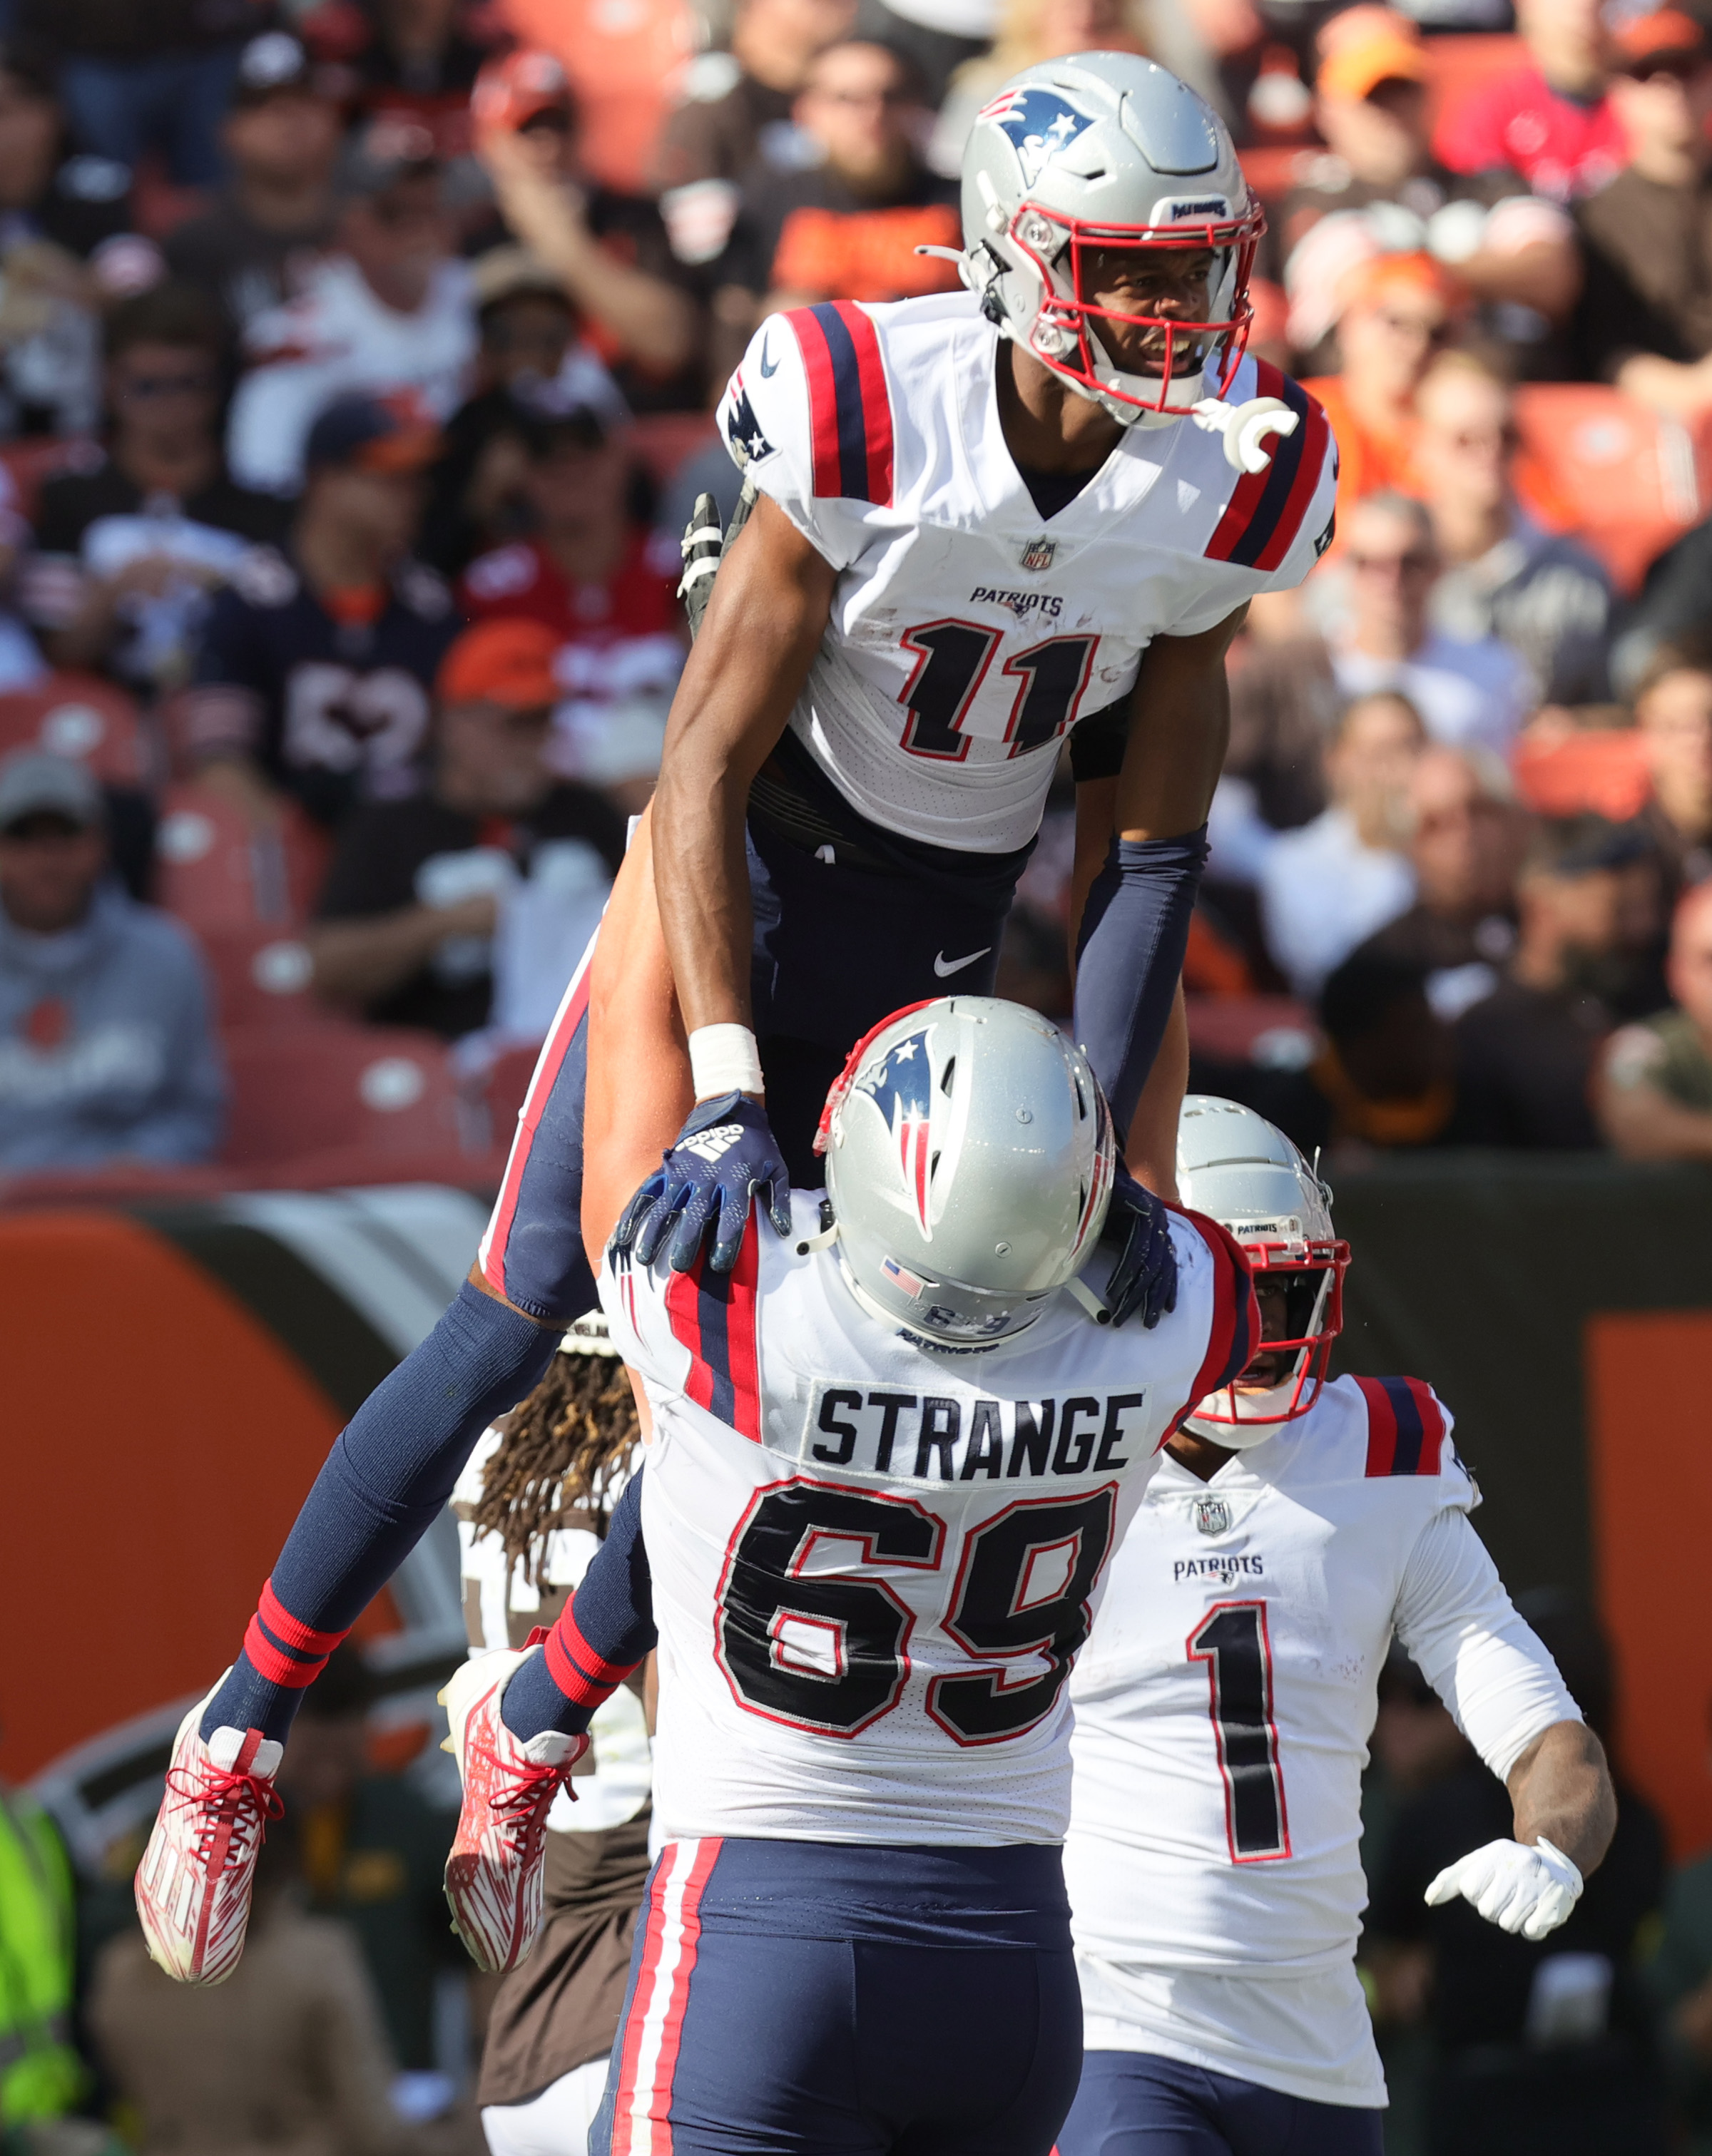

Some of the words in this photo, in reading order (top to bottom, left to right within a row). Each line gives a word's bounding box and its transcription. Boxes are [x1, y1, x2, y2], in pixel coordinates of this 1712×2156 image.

[1025, 553, 1051, 568] NFL
[969, 587, 1064, 617] PATRIOTS
[897, 618, 1101, 762] 11
[675, 1124, 745, 1153] adidas
[1238, 1223, 1278, 1235] PATRIOTS
[812, 1389, 1143, 1481] STRANGE
[1174, 1555, 1263, 1581] PATRIOTS
[713, 1475, 1119, 1747] 69
[1186, 1599, 1293, 1864] 1
